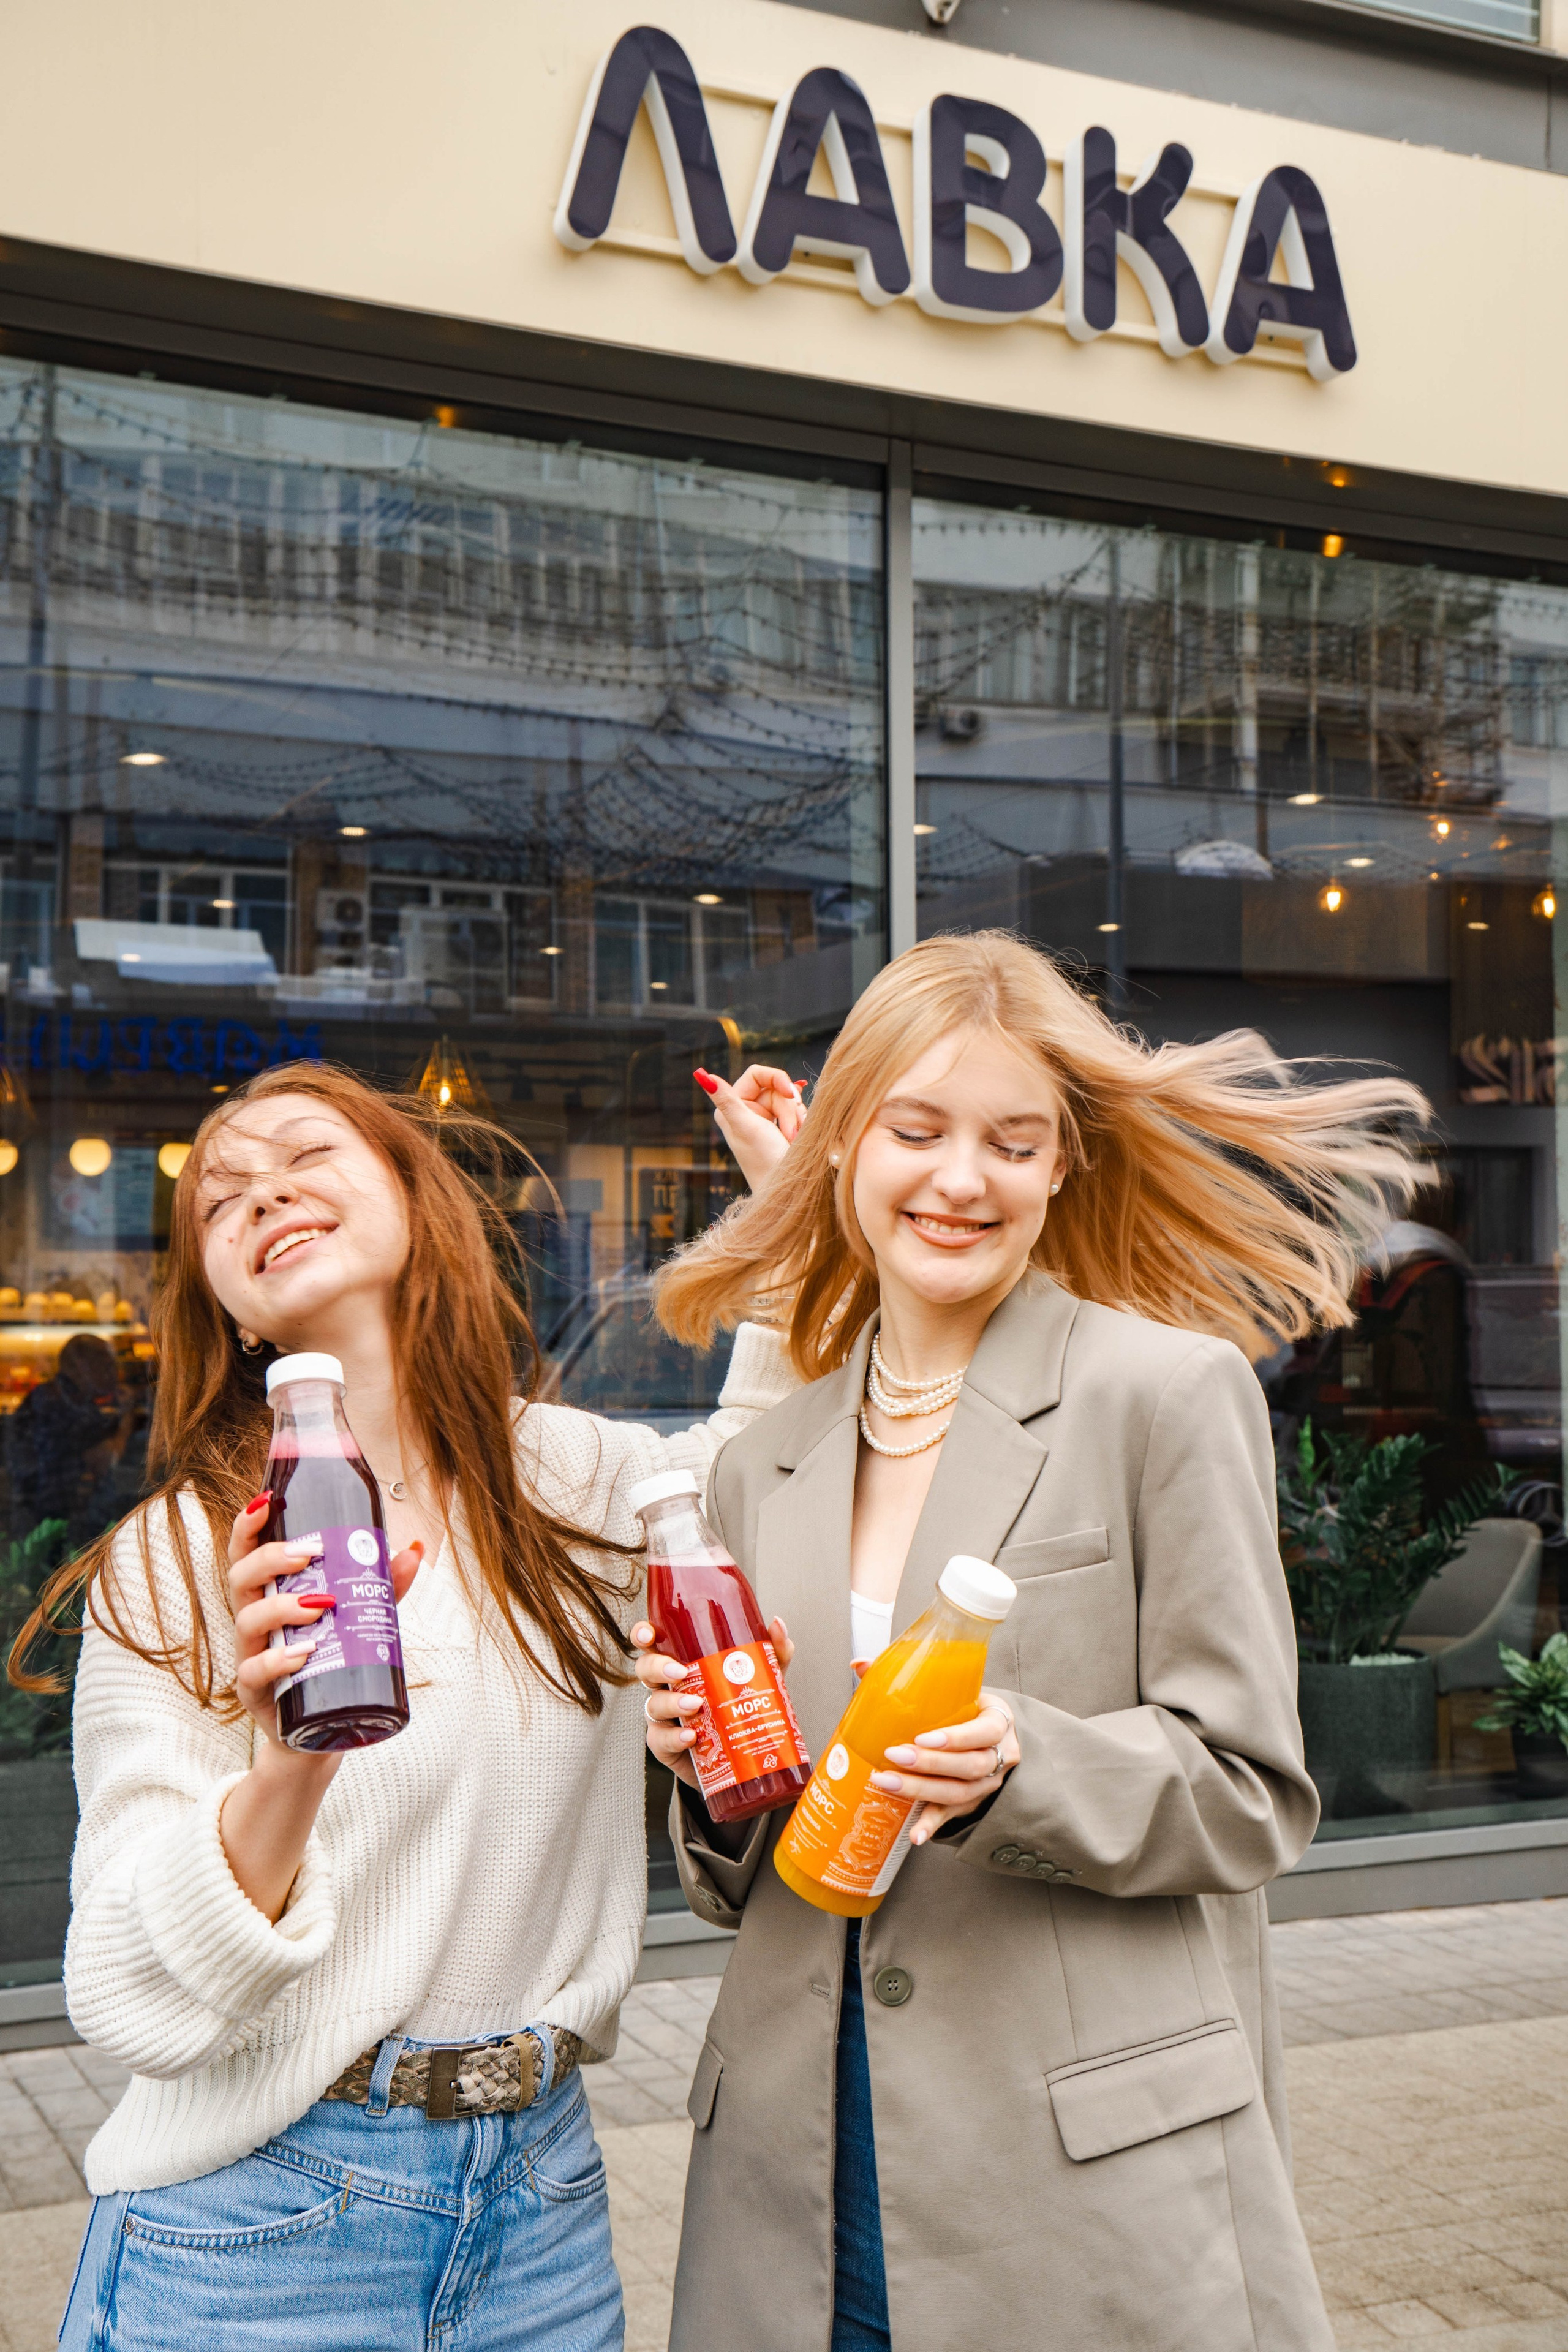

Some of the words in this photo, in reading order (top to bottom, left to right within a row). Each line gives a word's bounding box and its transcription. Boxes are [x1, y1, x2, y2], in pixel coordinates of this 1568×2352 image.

[561, 25, 1357, 375] ЛАВКА
[352, 1583, 389, 1599] МОРС
[731, 1696, 771, 1717] МОРС
[728, 1719, 786, 1741] КЛЮКВА-БРУСНИКА
[810, 1781, 835, 1815] МОРС
